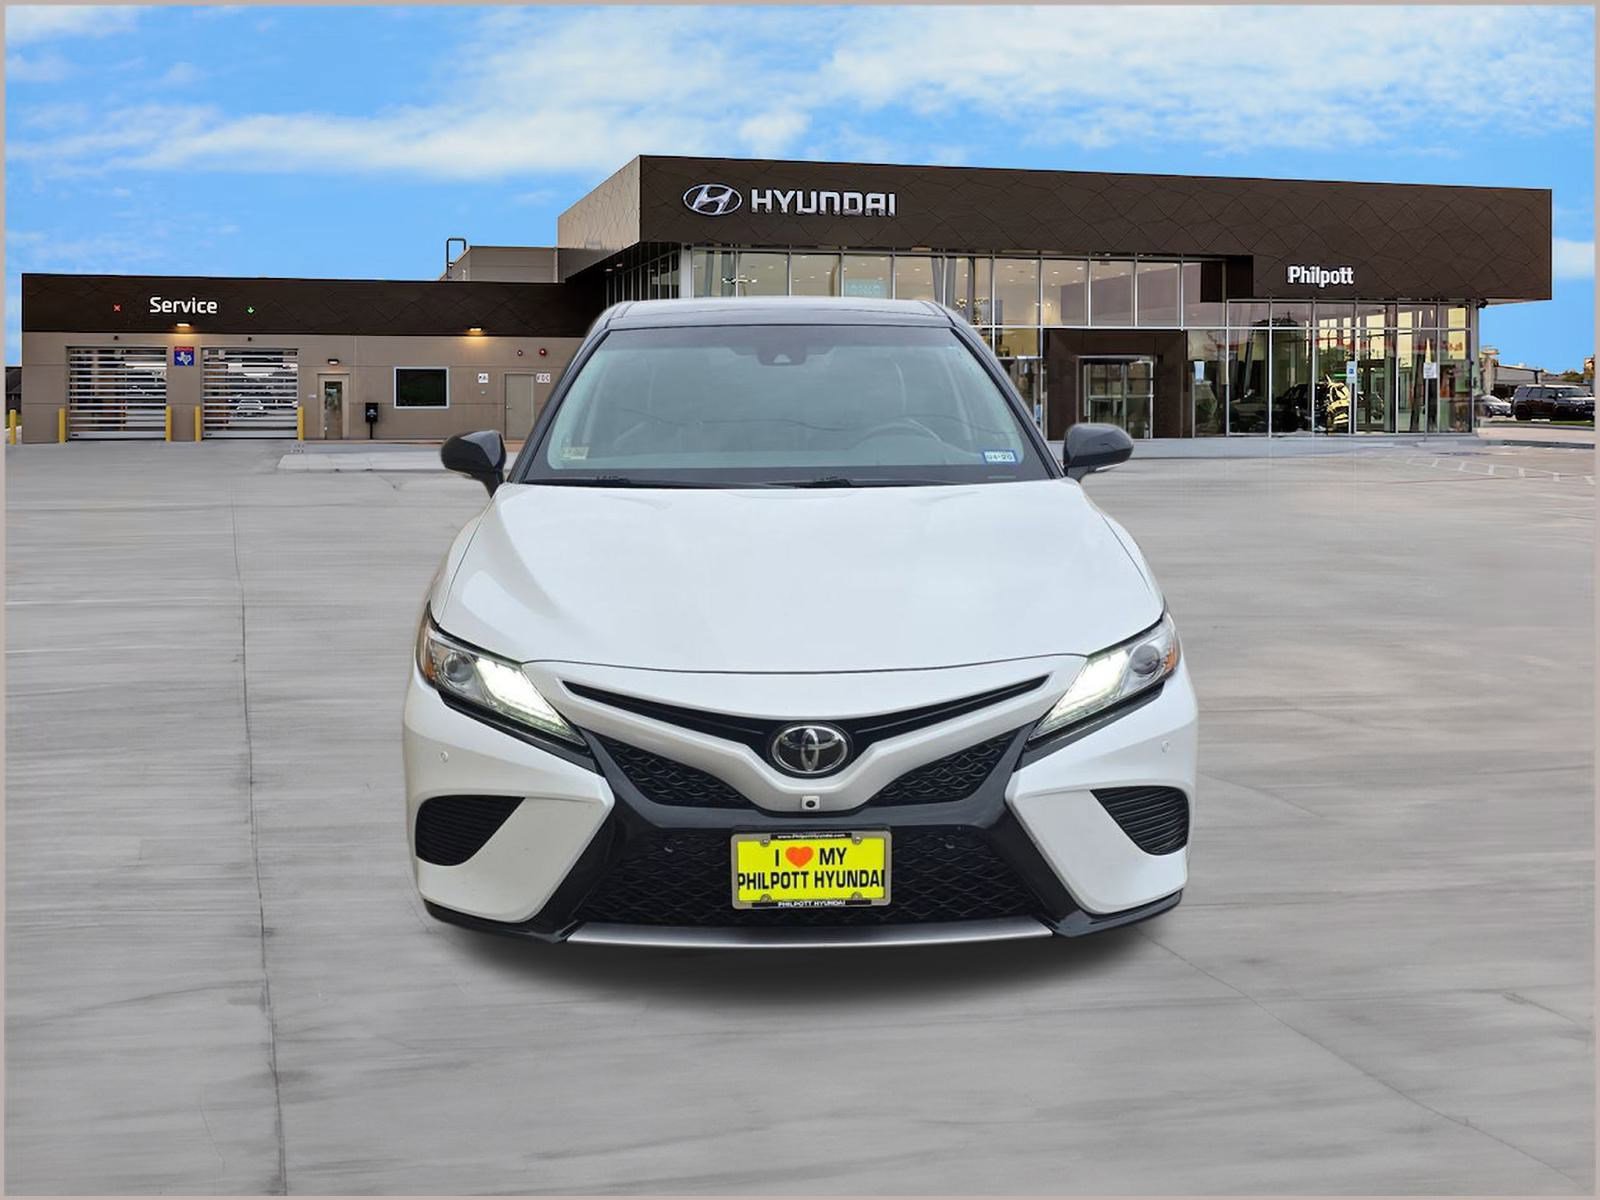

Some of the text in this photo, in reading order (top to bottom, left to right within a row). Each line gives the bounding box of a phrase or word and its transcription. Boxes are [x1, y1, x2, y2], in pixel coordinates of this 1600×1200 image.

[751, 188, 896, 216] HYUNDAI
[1287, 265, 1354, 288] Philpott
[149, 296, 218, 314] Service
[775, 847, 848, 867] I MY
[737, 869, 885, 890] PHILPOTT HYUNDAI
